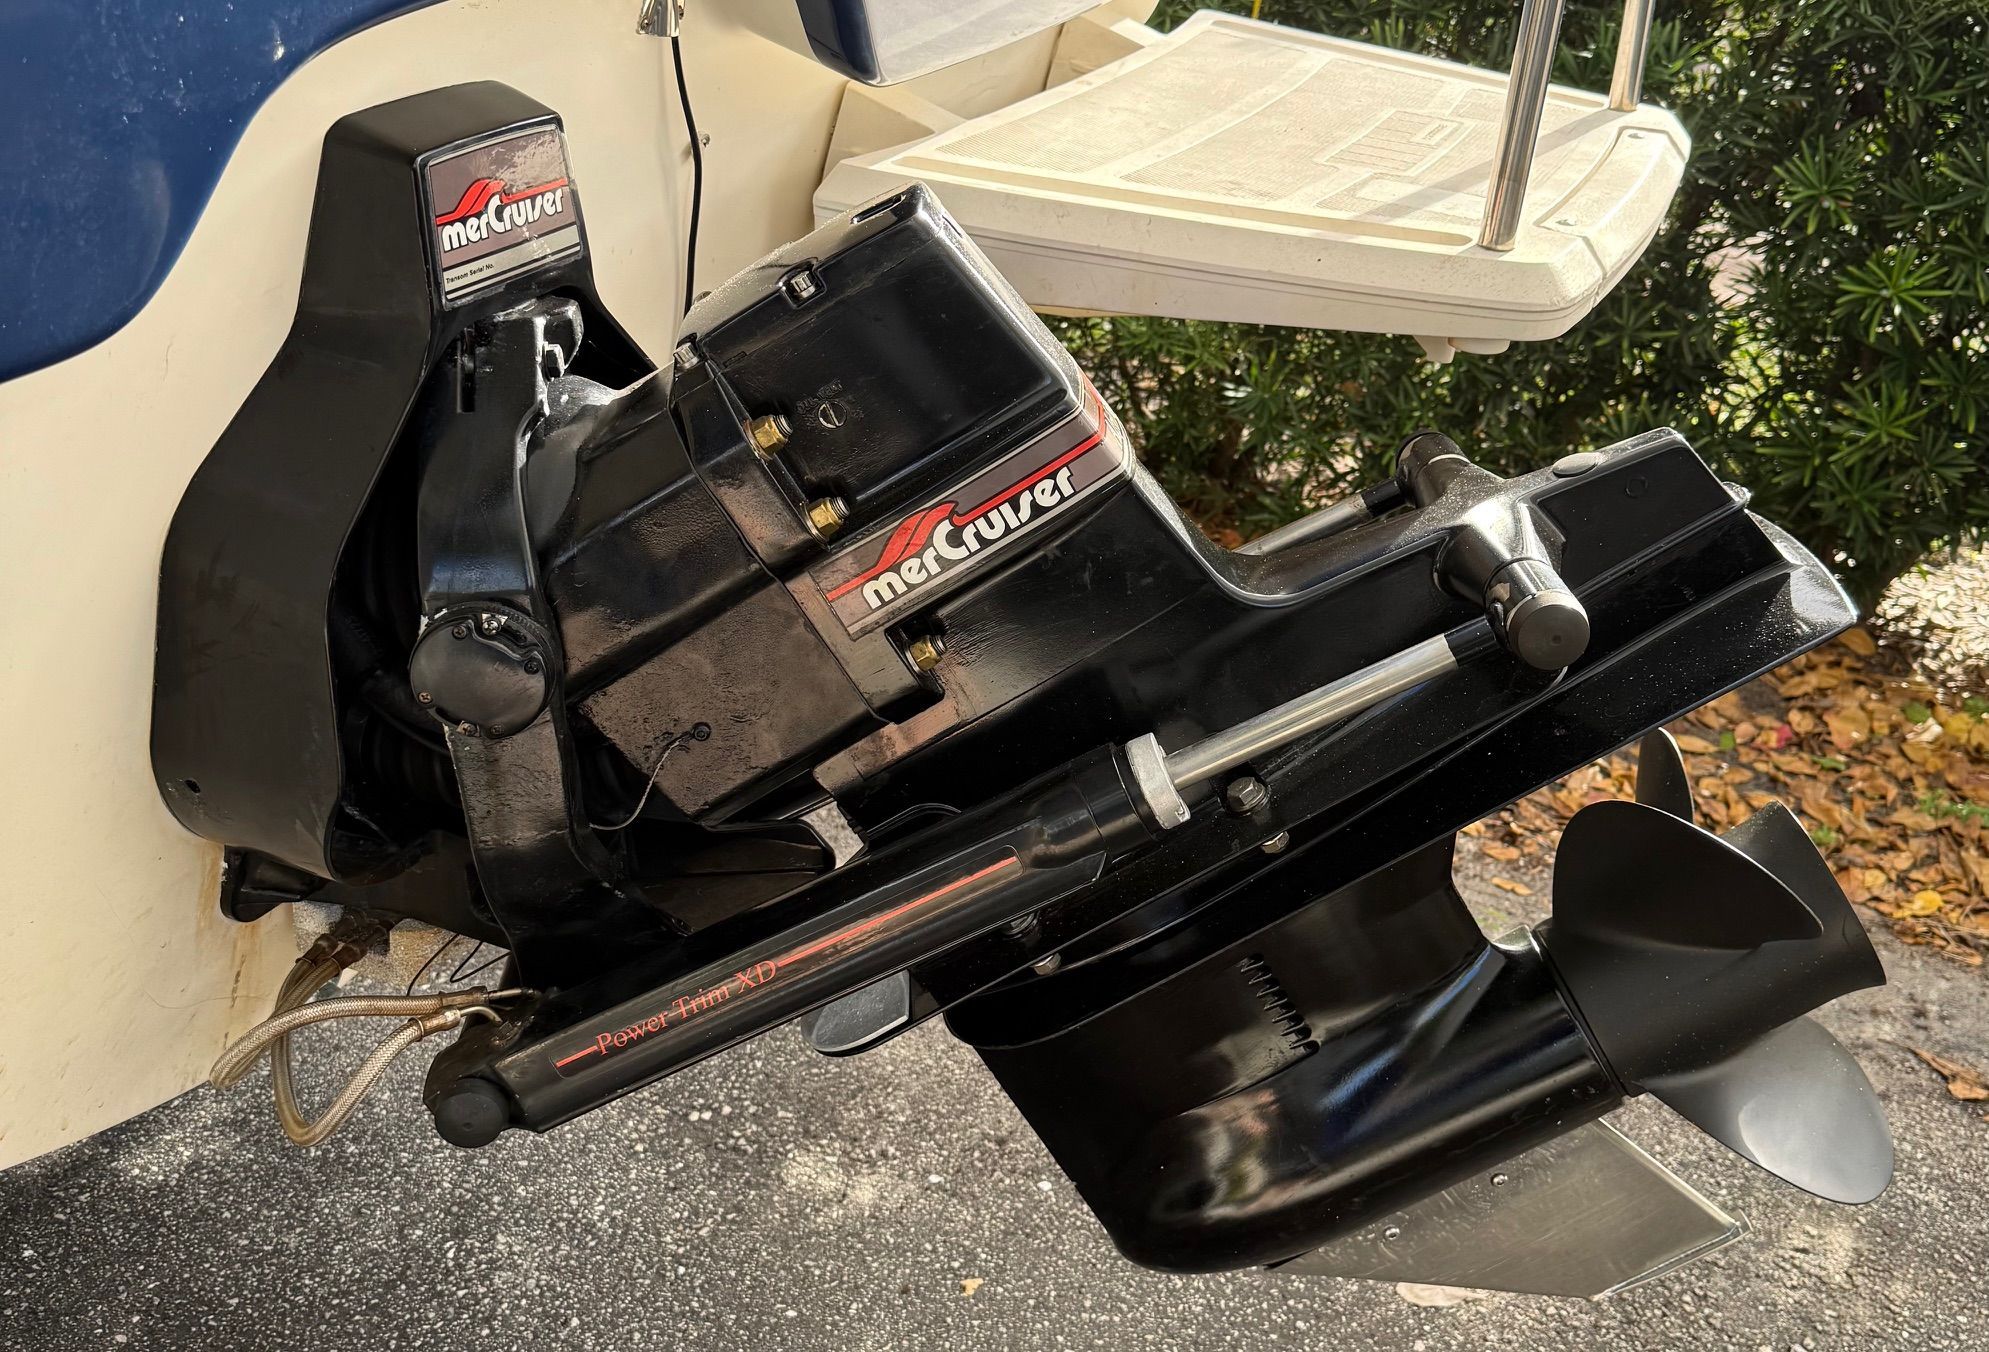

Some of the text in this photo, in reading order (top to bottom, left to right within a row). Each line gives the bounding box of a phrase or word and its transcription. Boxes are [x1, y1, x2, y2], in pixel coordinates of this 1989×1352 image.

[446, 272, 469, 284] Transom
[469, 265, 485, 276] Serial
[596, 959, 777, 1055] Power Trim XD
